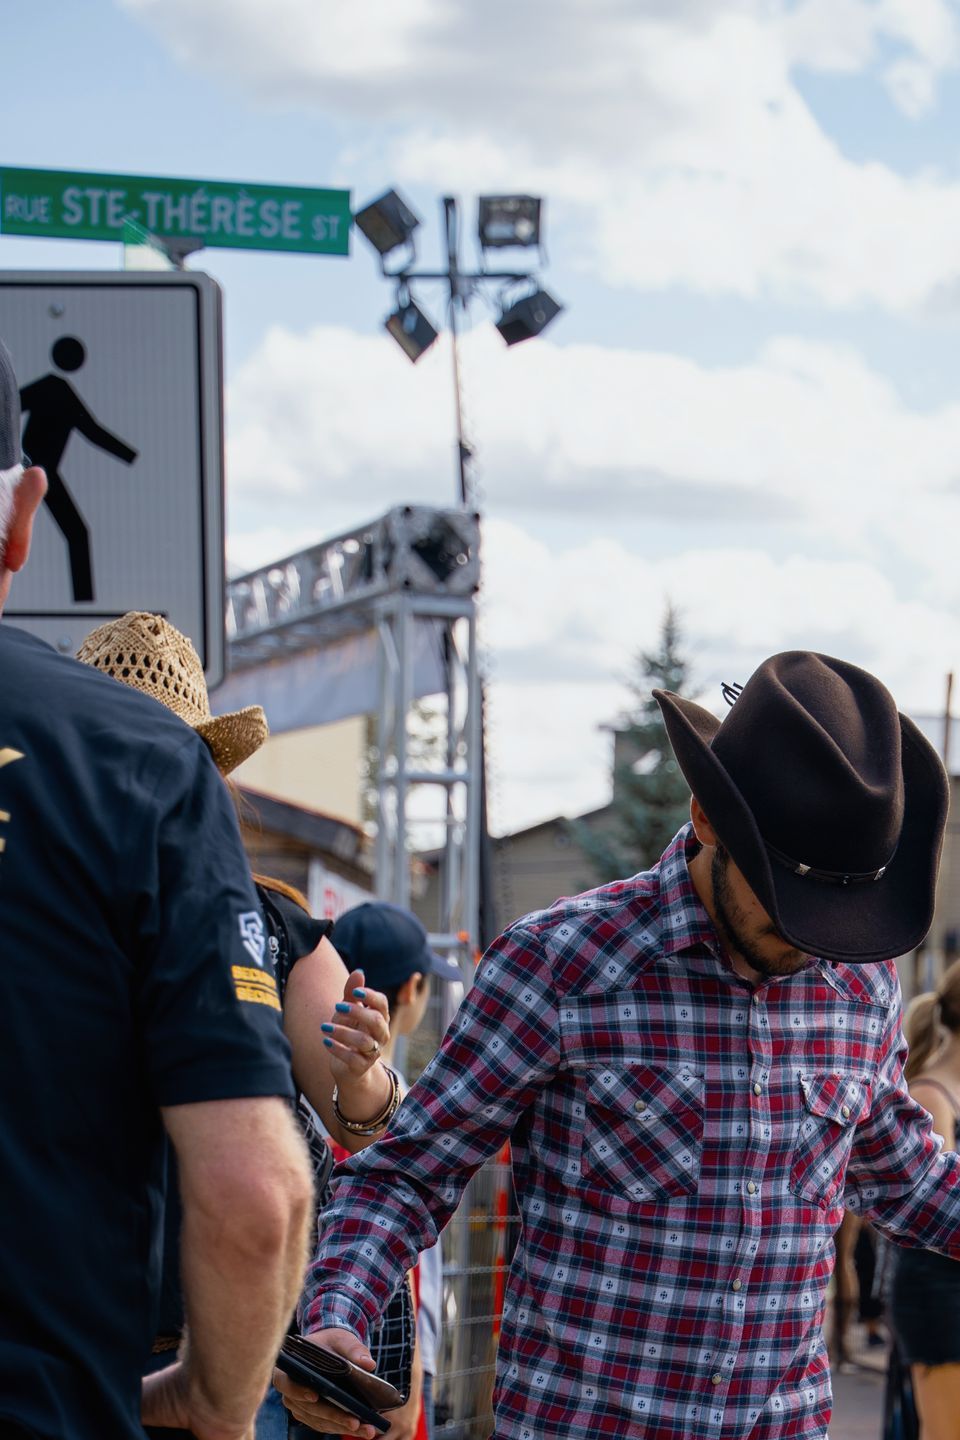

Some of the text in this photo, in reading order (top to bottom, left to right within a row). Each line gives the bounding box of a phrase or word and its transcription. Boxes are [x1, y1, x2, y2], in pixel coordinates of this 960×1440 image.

[5, 187, 340, 241] RUE STE-THÉRÈSE ST
